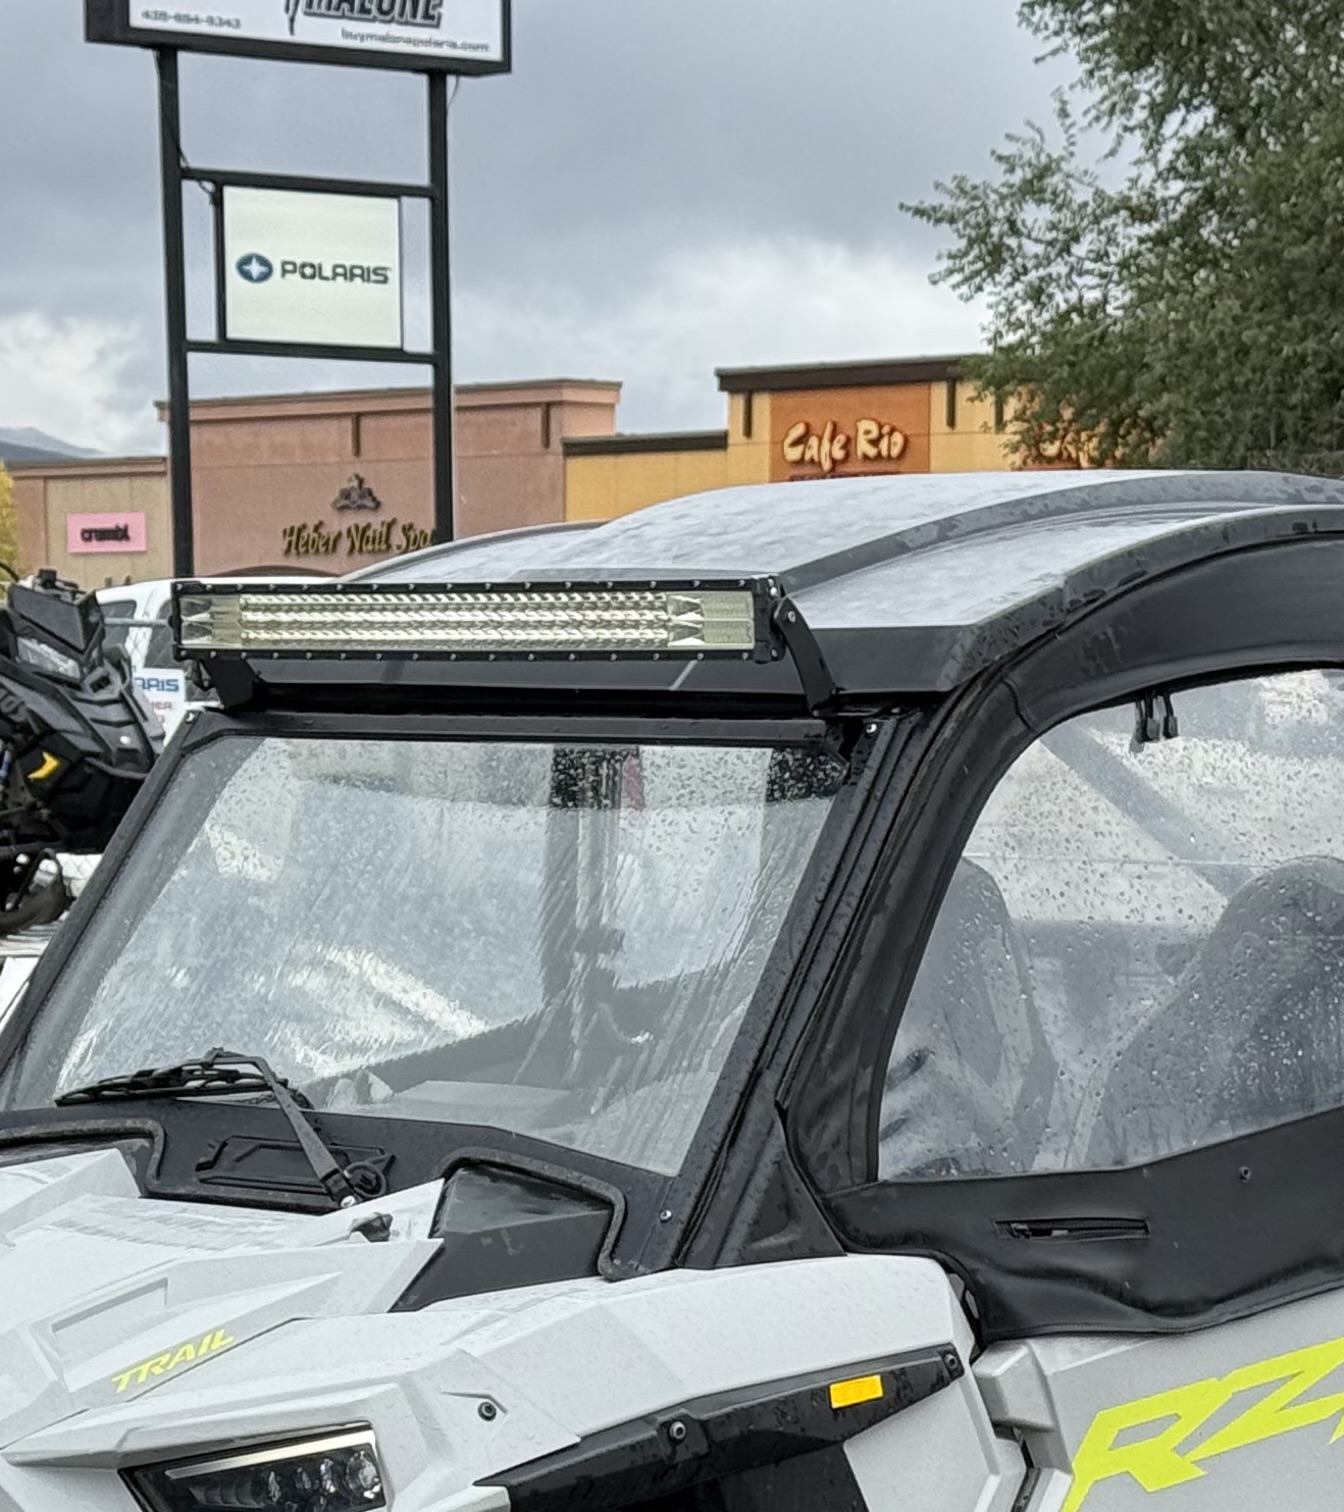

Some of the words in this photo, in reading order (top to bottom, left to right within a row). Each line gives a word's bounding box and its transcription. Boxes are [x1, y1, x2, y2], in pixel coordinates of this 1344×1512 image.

[280, 260, 391, 285] POLARIS
[784, 420, 848, 472] Cafe
[856, 418, 905, 460] Rio
[283, 521, 342, 556] Heber
[346, 518, 397, 556] Nail
[395, 522, 436, 553] Spa
[111, 1328, 235, 1393] TRAIL
